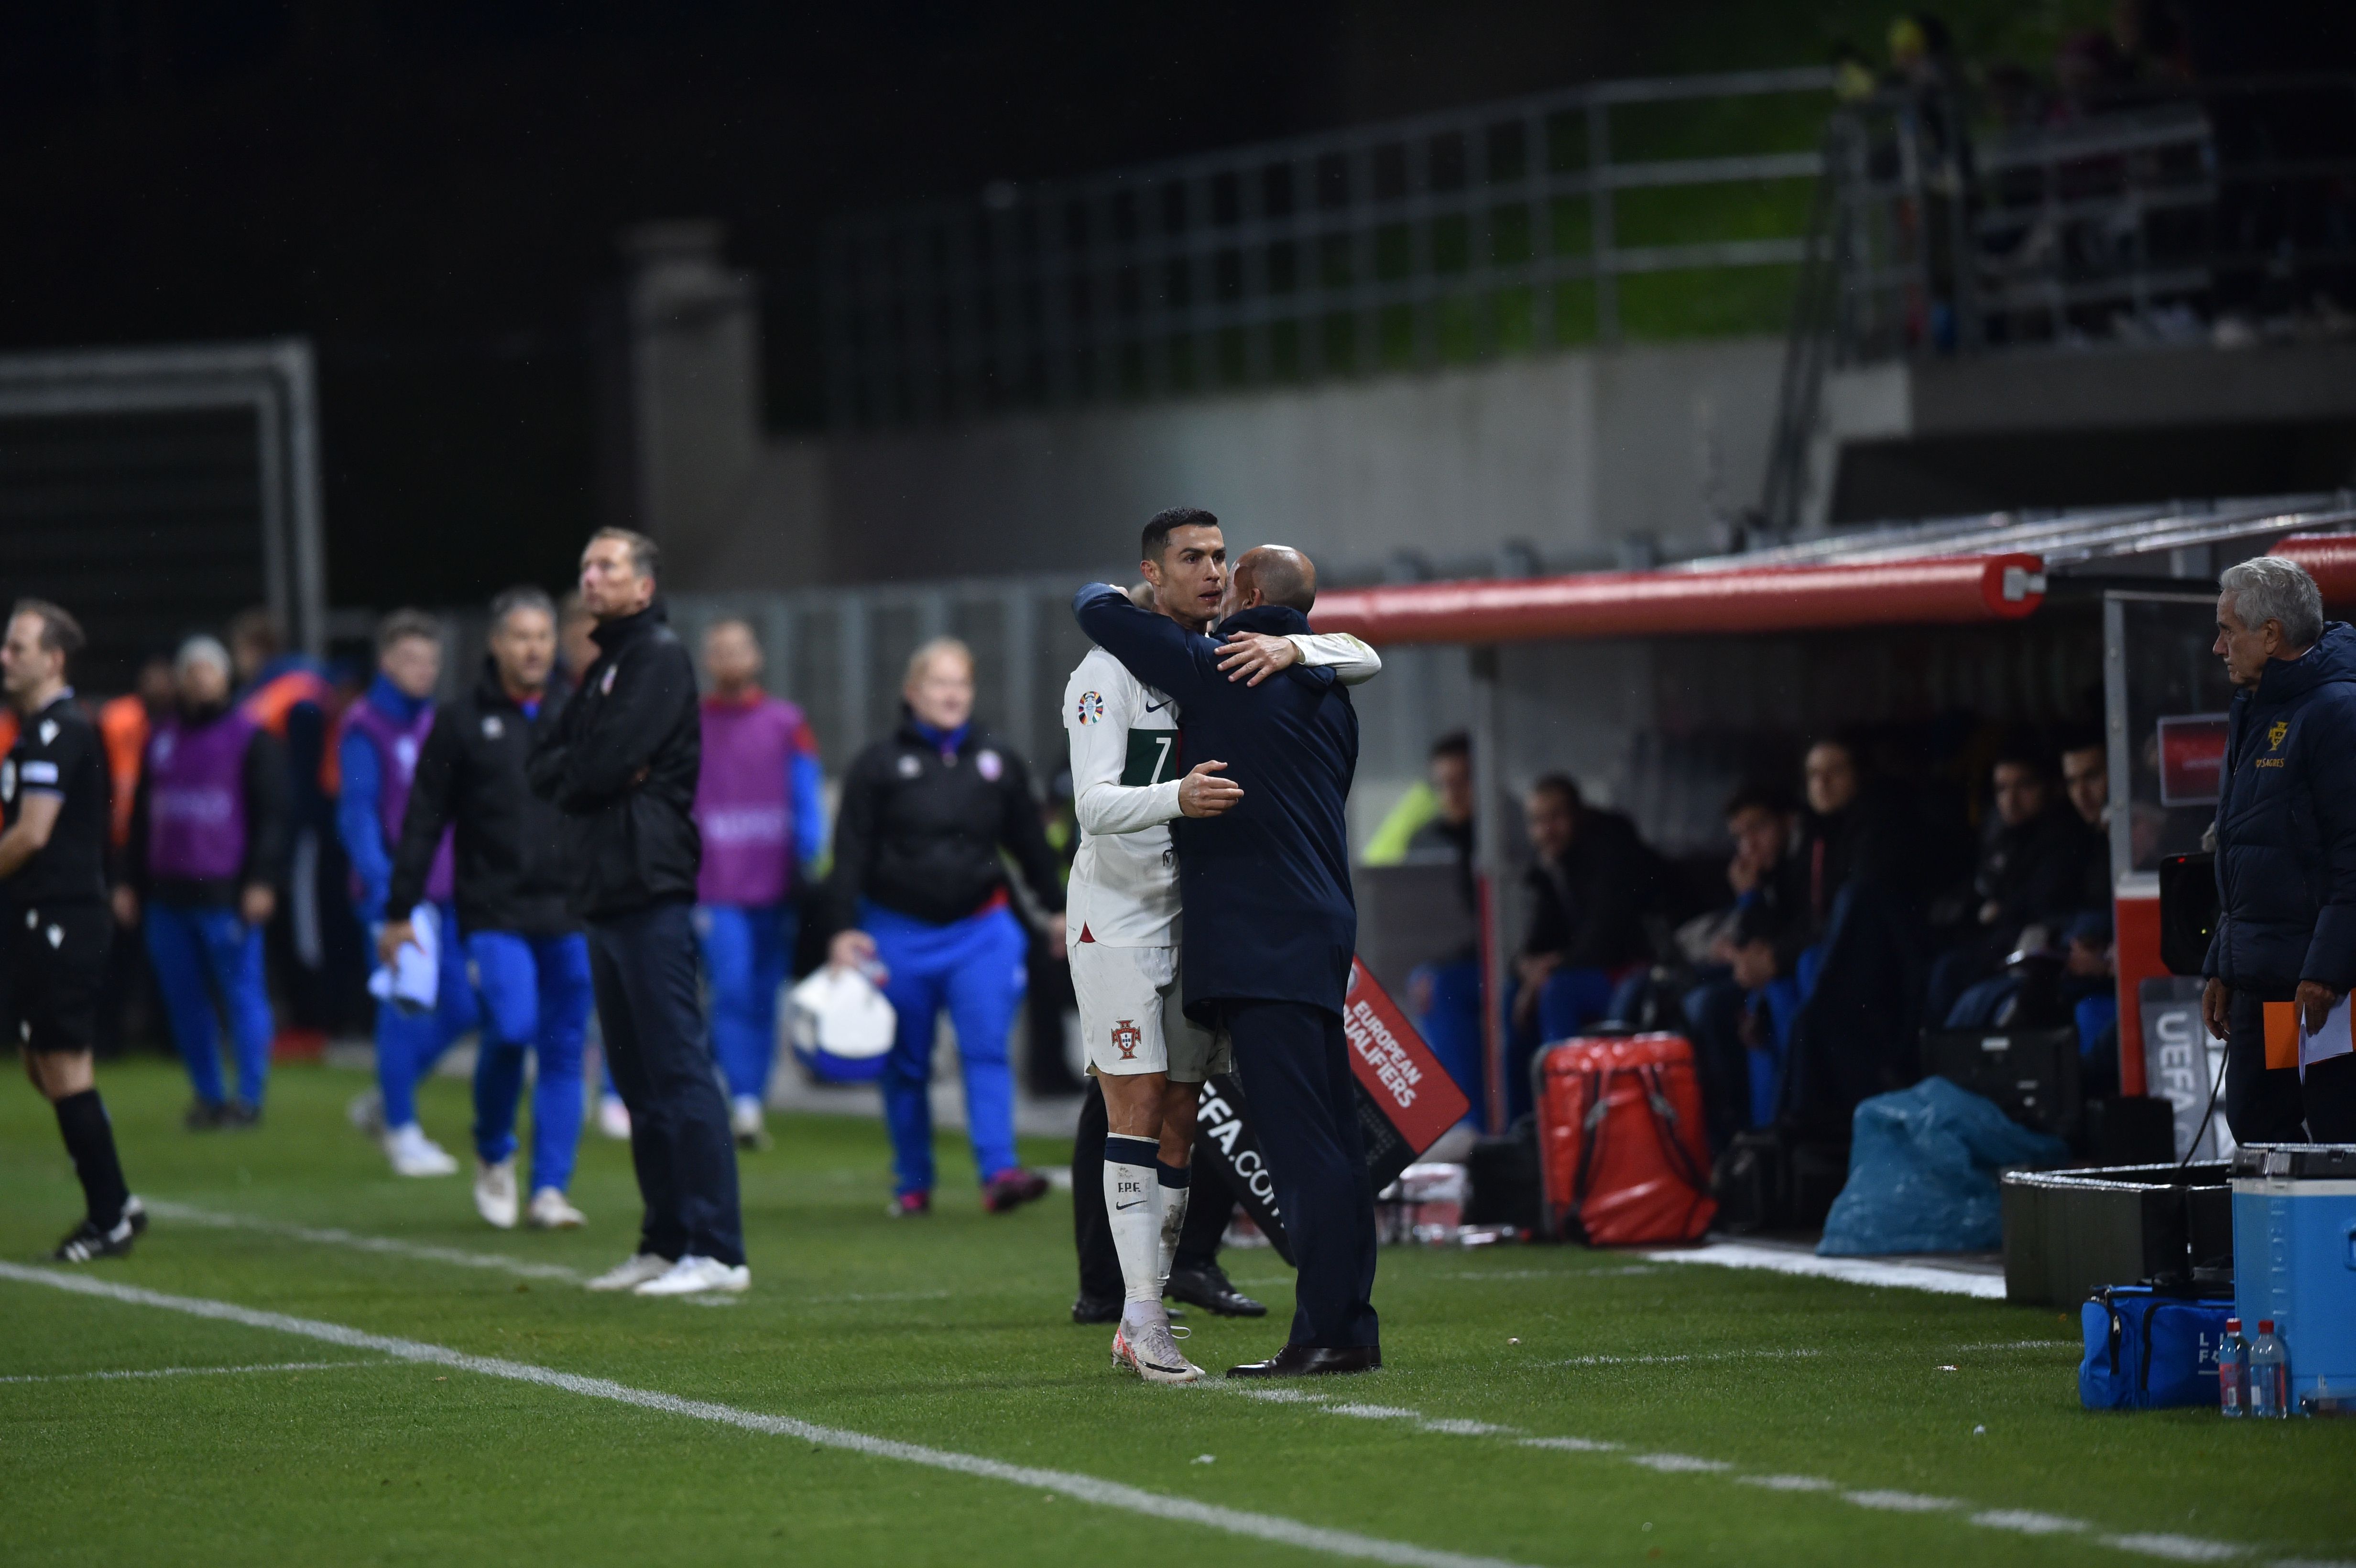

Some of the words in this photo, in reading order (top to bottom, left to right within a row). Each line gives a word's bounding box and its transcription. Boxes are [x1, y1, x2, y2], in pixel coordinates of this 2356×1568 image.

[1150, 737, 1172, 784] 7
[2261, 757, 2285, 768] SAGRES
[1353, 999, 1423, 1086] EUROPEAN
